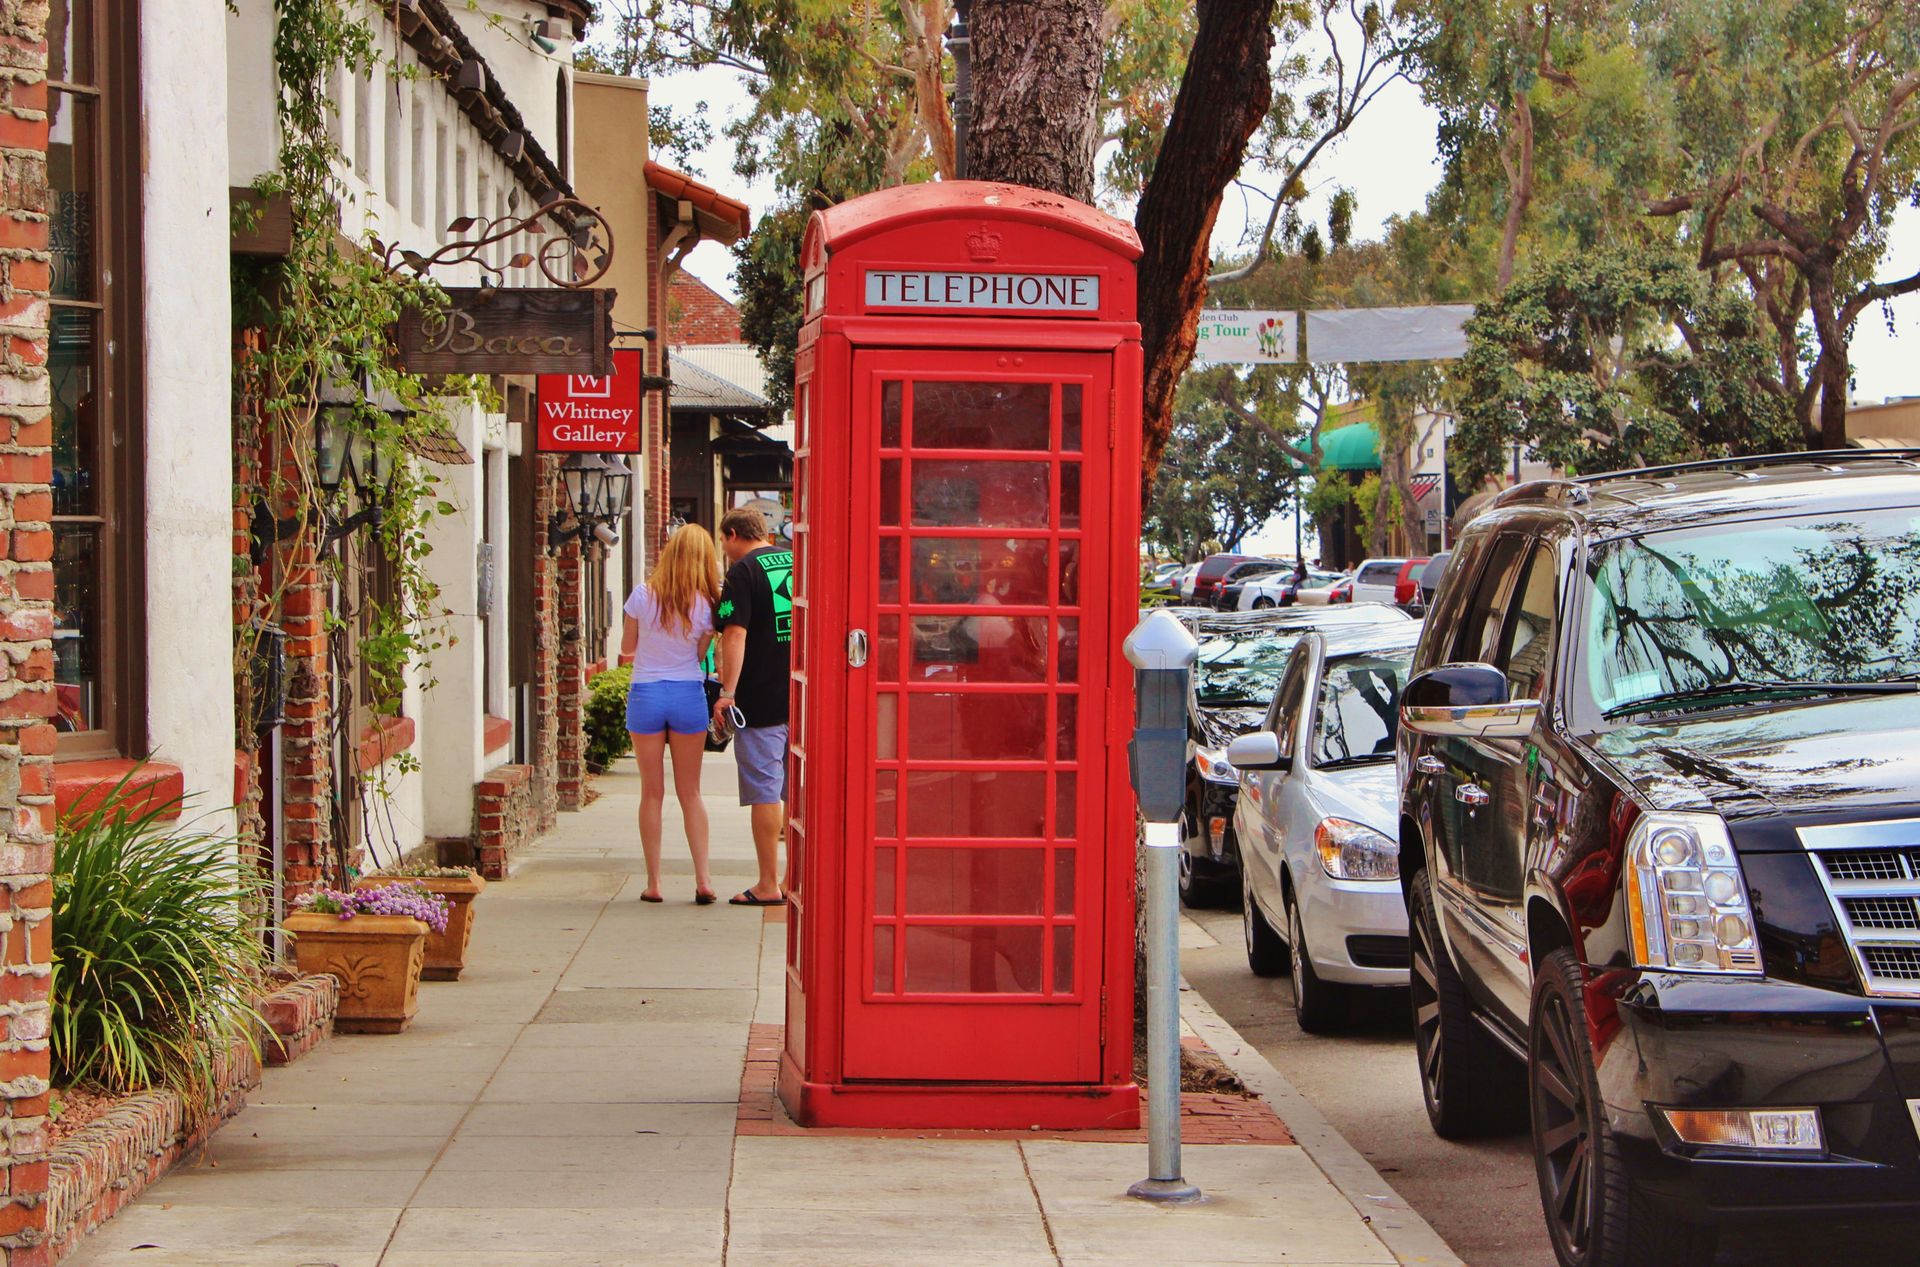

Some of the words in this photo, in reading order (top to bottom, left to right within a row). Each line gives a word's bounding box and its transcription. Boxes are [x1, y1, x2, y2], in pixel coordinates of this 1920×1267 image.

[873, 274, 1089, 305] TELEPHONE
[1218, 313, 1239, 322] Club
[420, 308, 582, 356] Baca
[1213, 324, 1250, 336] Tour
[543, 401, 634, 425] Whitney
[552, 424, 627, 448] Gallery
